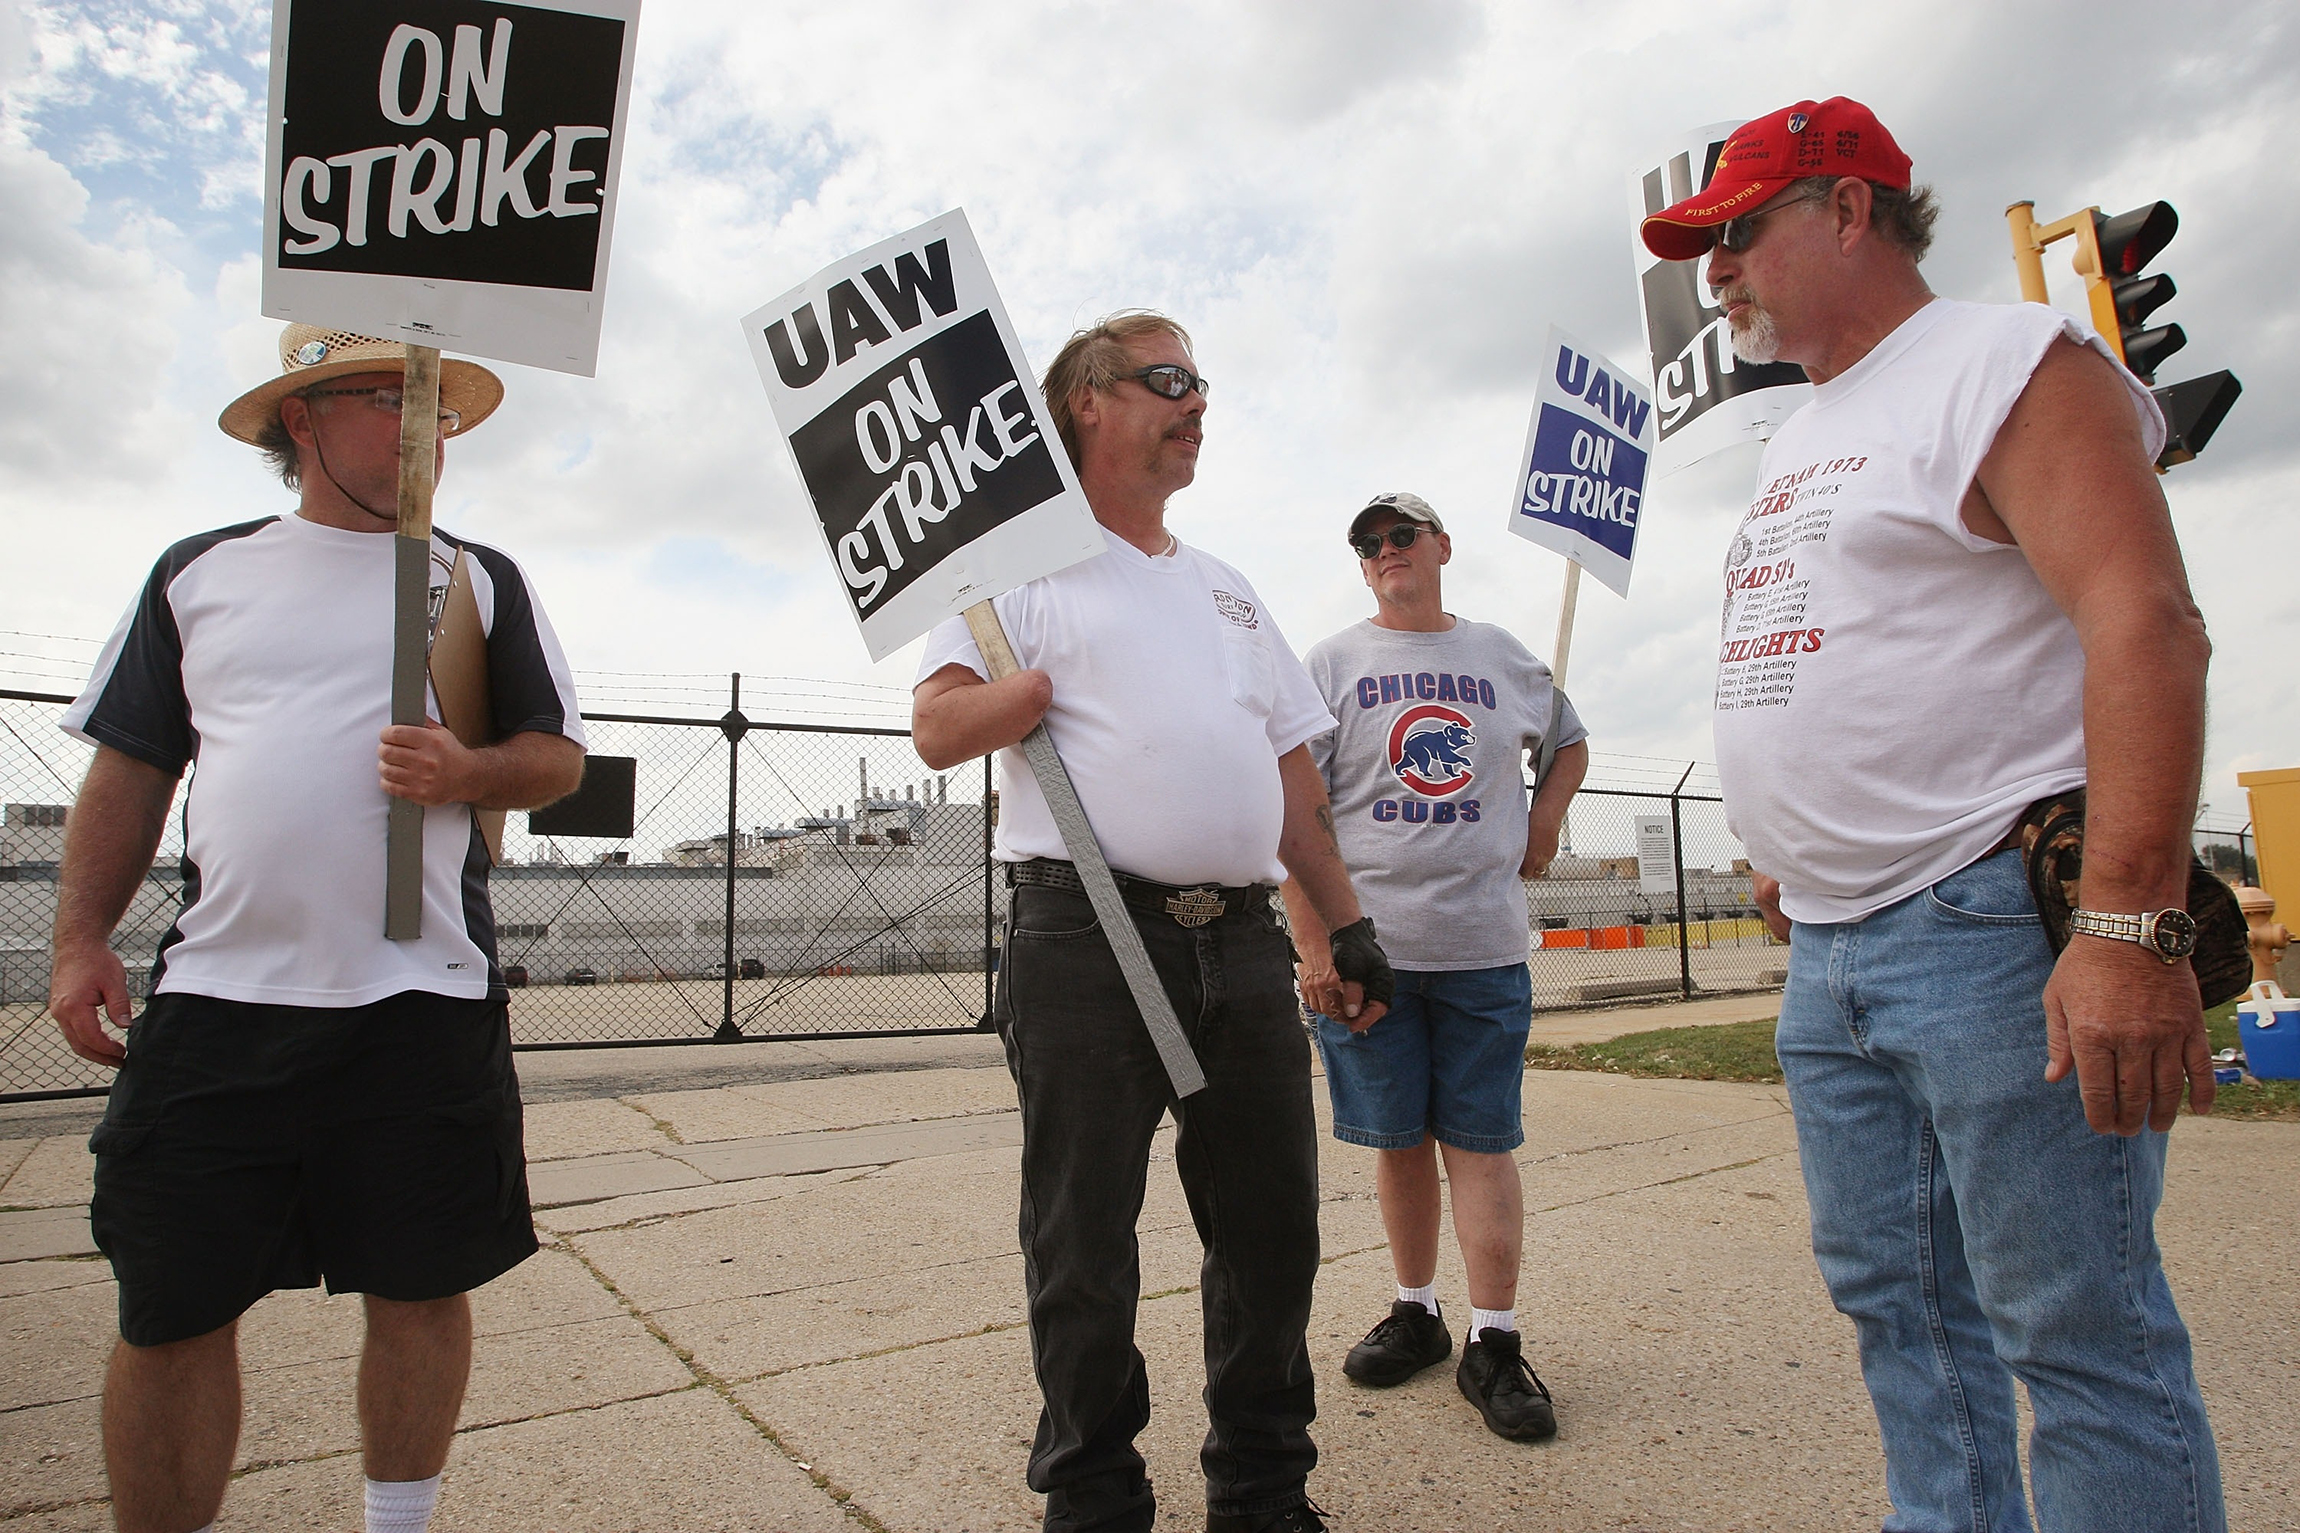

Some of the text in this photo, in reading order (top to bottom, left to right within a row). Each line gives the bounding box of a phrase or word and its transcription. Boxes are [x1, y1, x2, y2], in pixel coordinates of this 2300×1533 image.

[379, 17, 513, 126] ON
[283, 126, 610, 255] STRIKE
[1685, 182, 1763, 216] FIRST TO FIRE
[763, 237, 958, 389] UAW
[1555, 344, 1651, 441] UAW
[855, 357, 943, 474] ON
[1570, 429, 1615, 478] ON
[1822, 456, 1868, 476] 1973
[837, 379, 1039, 609] STRIKE
[1524, 470, 1640, 528] STRIKE
[1799, 532, 1827, 542] Artillery
[1726, 565, 1772, 598] QUAD
[1772, 615, 1805, 625] Artillery
[1745, 674, 1760, 685] 29th
[1760, 671, 1796, 682] Artillery
[1748, 662, 1762, 673] 29th
[1763, 660, 1797, 670] Artillery
[1356, 672, 1497, 711] CHICAGO
[1740, 699, 1755, 709] 29th
[1755, 696, 1790, 707] Artillery
[1744, 686, 1759, 697] 29th
[1759, 684, 1795, 695] Artillery
[1372, 799, 1481, 824] CUBS
[1644, 824, 1664, 834] NOTICE
[1185, 894, 1215, 904] MOTOR
[1179, 914, 1207, 925] CYCLES
